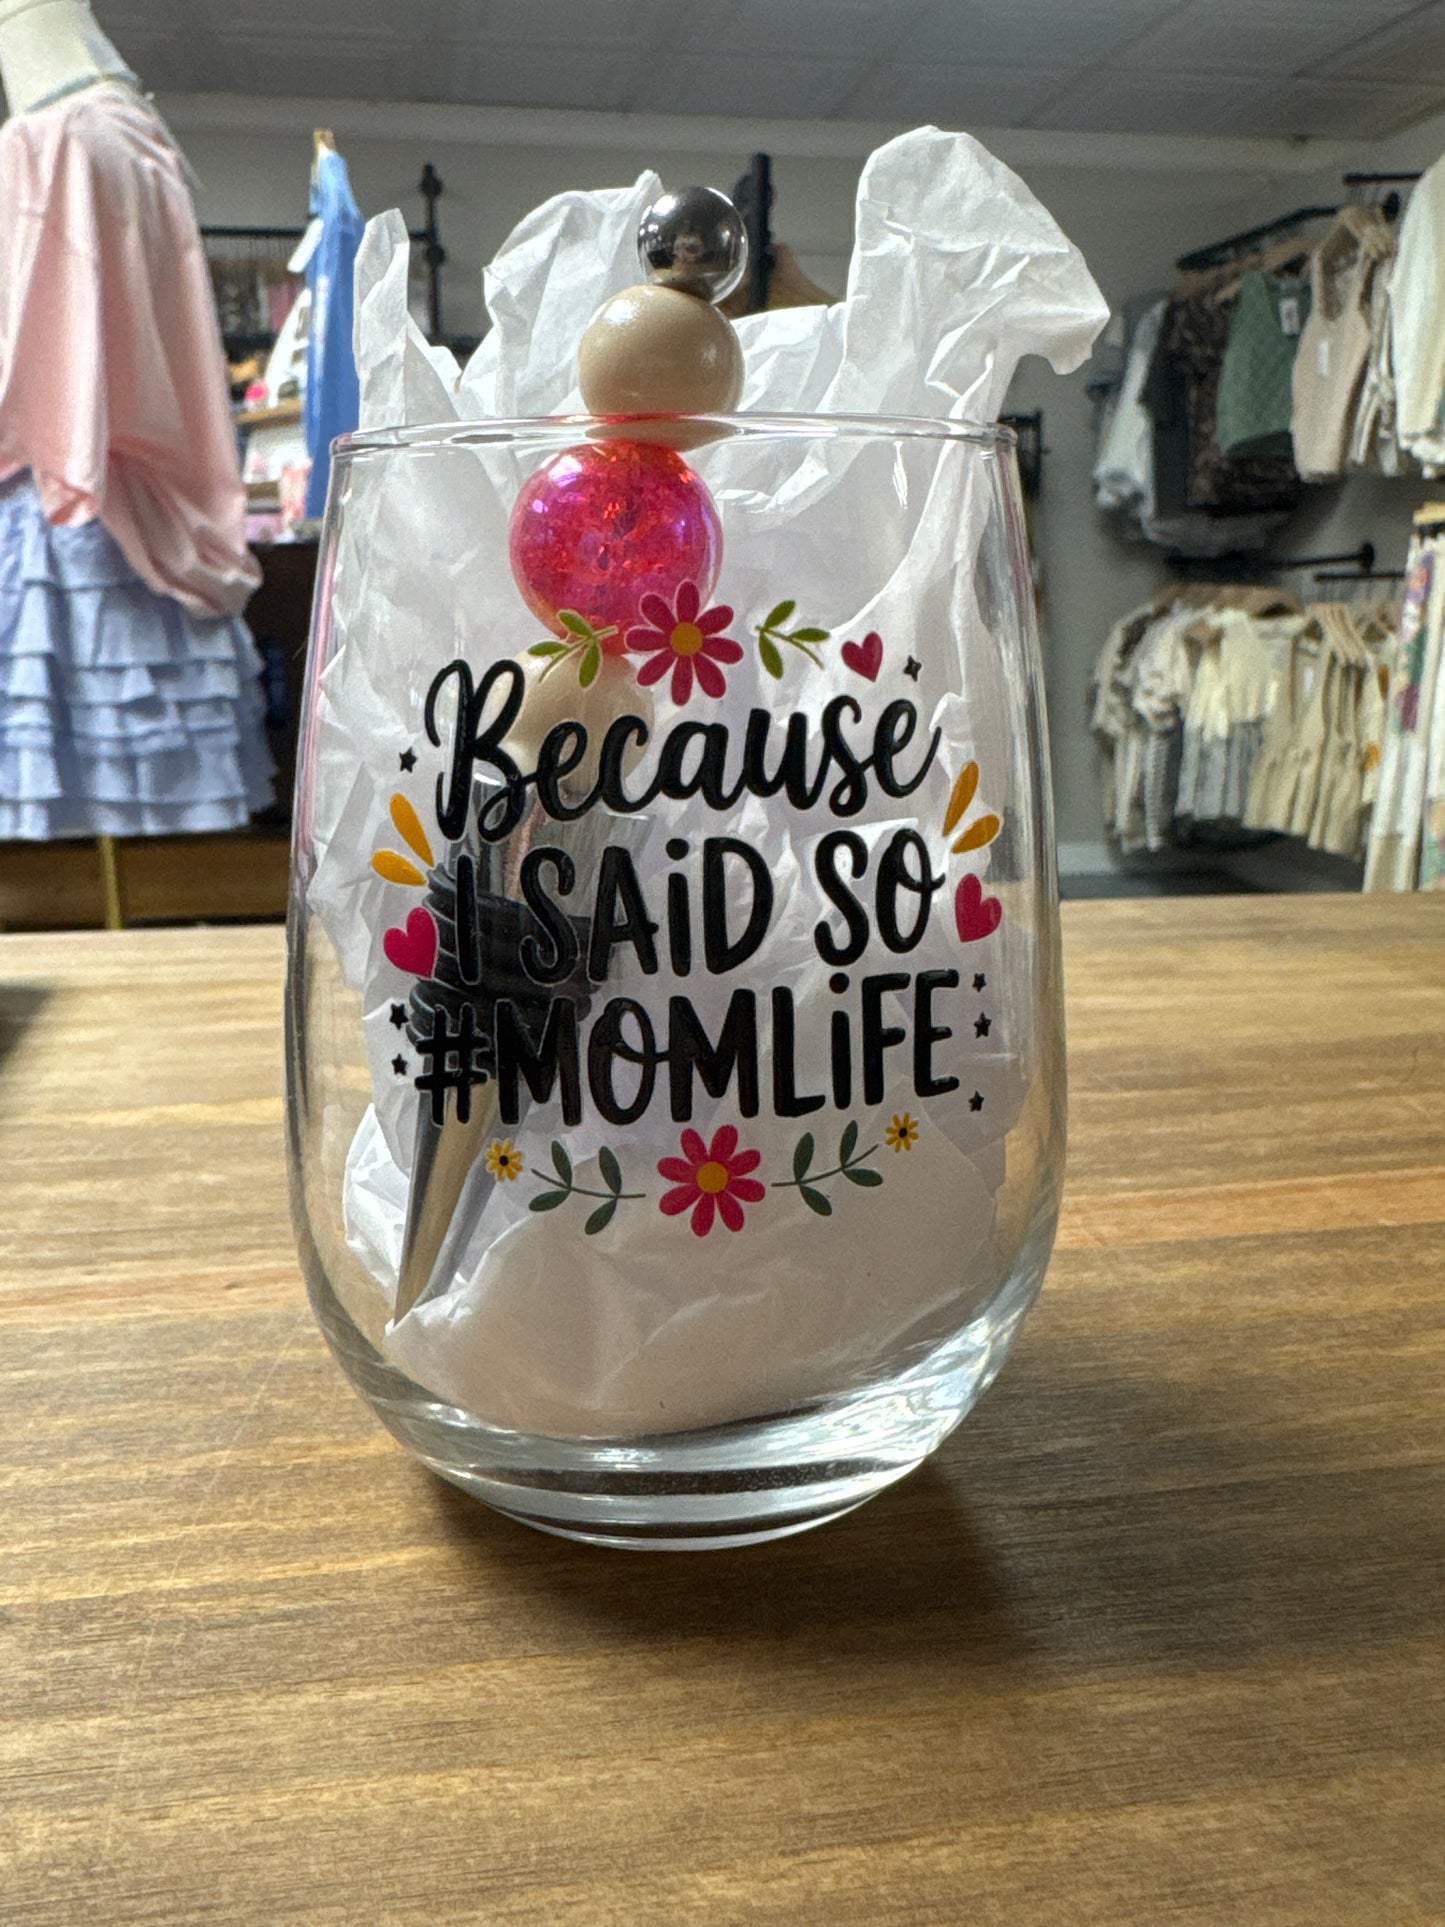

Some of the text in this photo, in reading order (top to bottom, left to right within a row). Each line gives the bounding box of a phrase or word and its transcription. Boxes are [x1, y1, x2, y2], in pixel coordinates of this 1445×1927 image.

[424, 659, 943, 843] Because
[453, 853, 481, 985] I
[814, 828, 946, 967] SO
